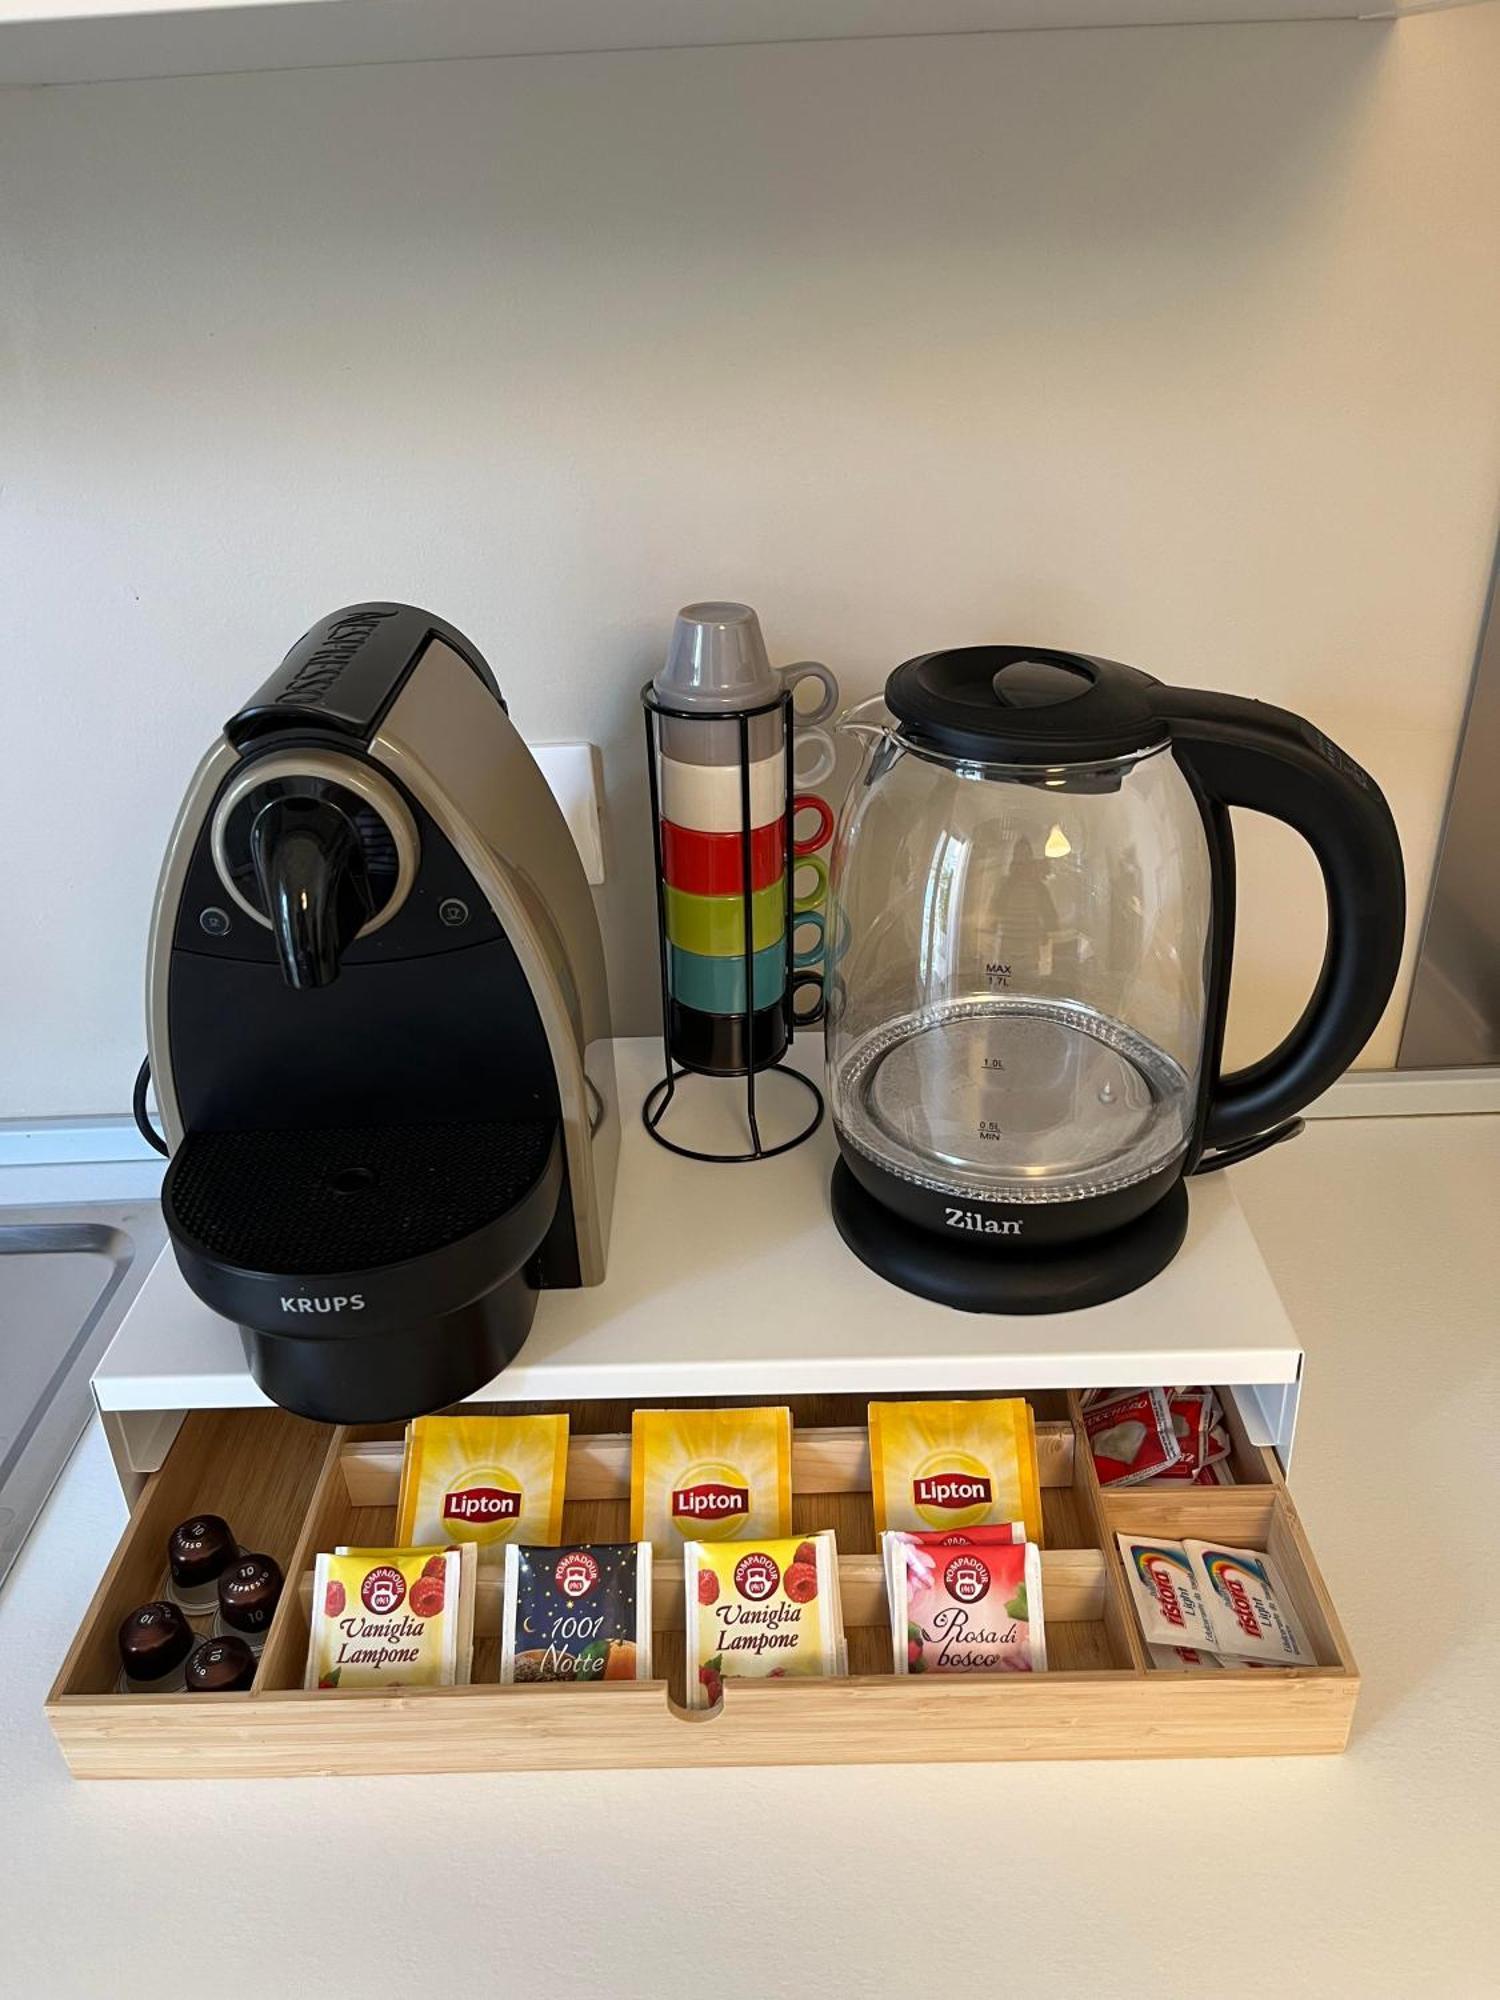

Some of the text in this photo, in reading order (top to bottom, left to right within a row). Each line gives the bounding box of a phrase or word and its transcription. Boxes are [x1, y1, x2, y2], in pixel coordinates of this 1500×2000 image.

[274, 610, 398, 704] NESPRESSO
[985, 963, 1012, 974] MAX
[979, 1132, 1001, 1141] MIN
[945, 1207, 1021, 1235] Zilan
[280, 1294, 366, 1313] KRUPS
[678, 1491, 743, 1514] Lipton
[919, 1481, 986, 1503] Lipton
[450, 1495, 514, 1517] Lipton
[192, 1524, 206, 1536] 10
[240, 1565, 255, 1578] 10
[556, 1554, 598, 1580] POMPADOUR
[735, 1555, 778, 1582] POMPADOUR
[946, 1556, 989, 1583] POMPADOUR
[362, 1568, 404, 1594] POMPADOUR
[1151, 1570, 1187, 1629] ristora
[1178, 1587, 1196, 1617] Light
[1224, 1580, 1264, 1640] ristora
[1252, 1597, 1272, 1628] Light
[551, 1615, 605, 1639] 1001
[715, 1601, 802, 1630] Vaniglia
[921, 1607, 1017, 1644] Rosa di
[340, 1615, 425, 1644] Vaniglia
[336, 1643, 420, 1669] Lampone
[716, 1630, 799, 1656] Lampone
[937, 1637, 1000, 1668] bosco
[540, 1642, 605, 1673] Notte
